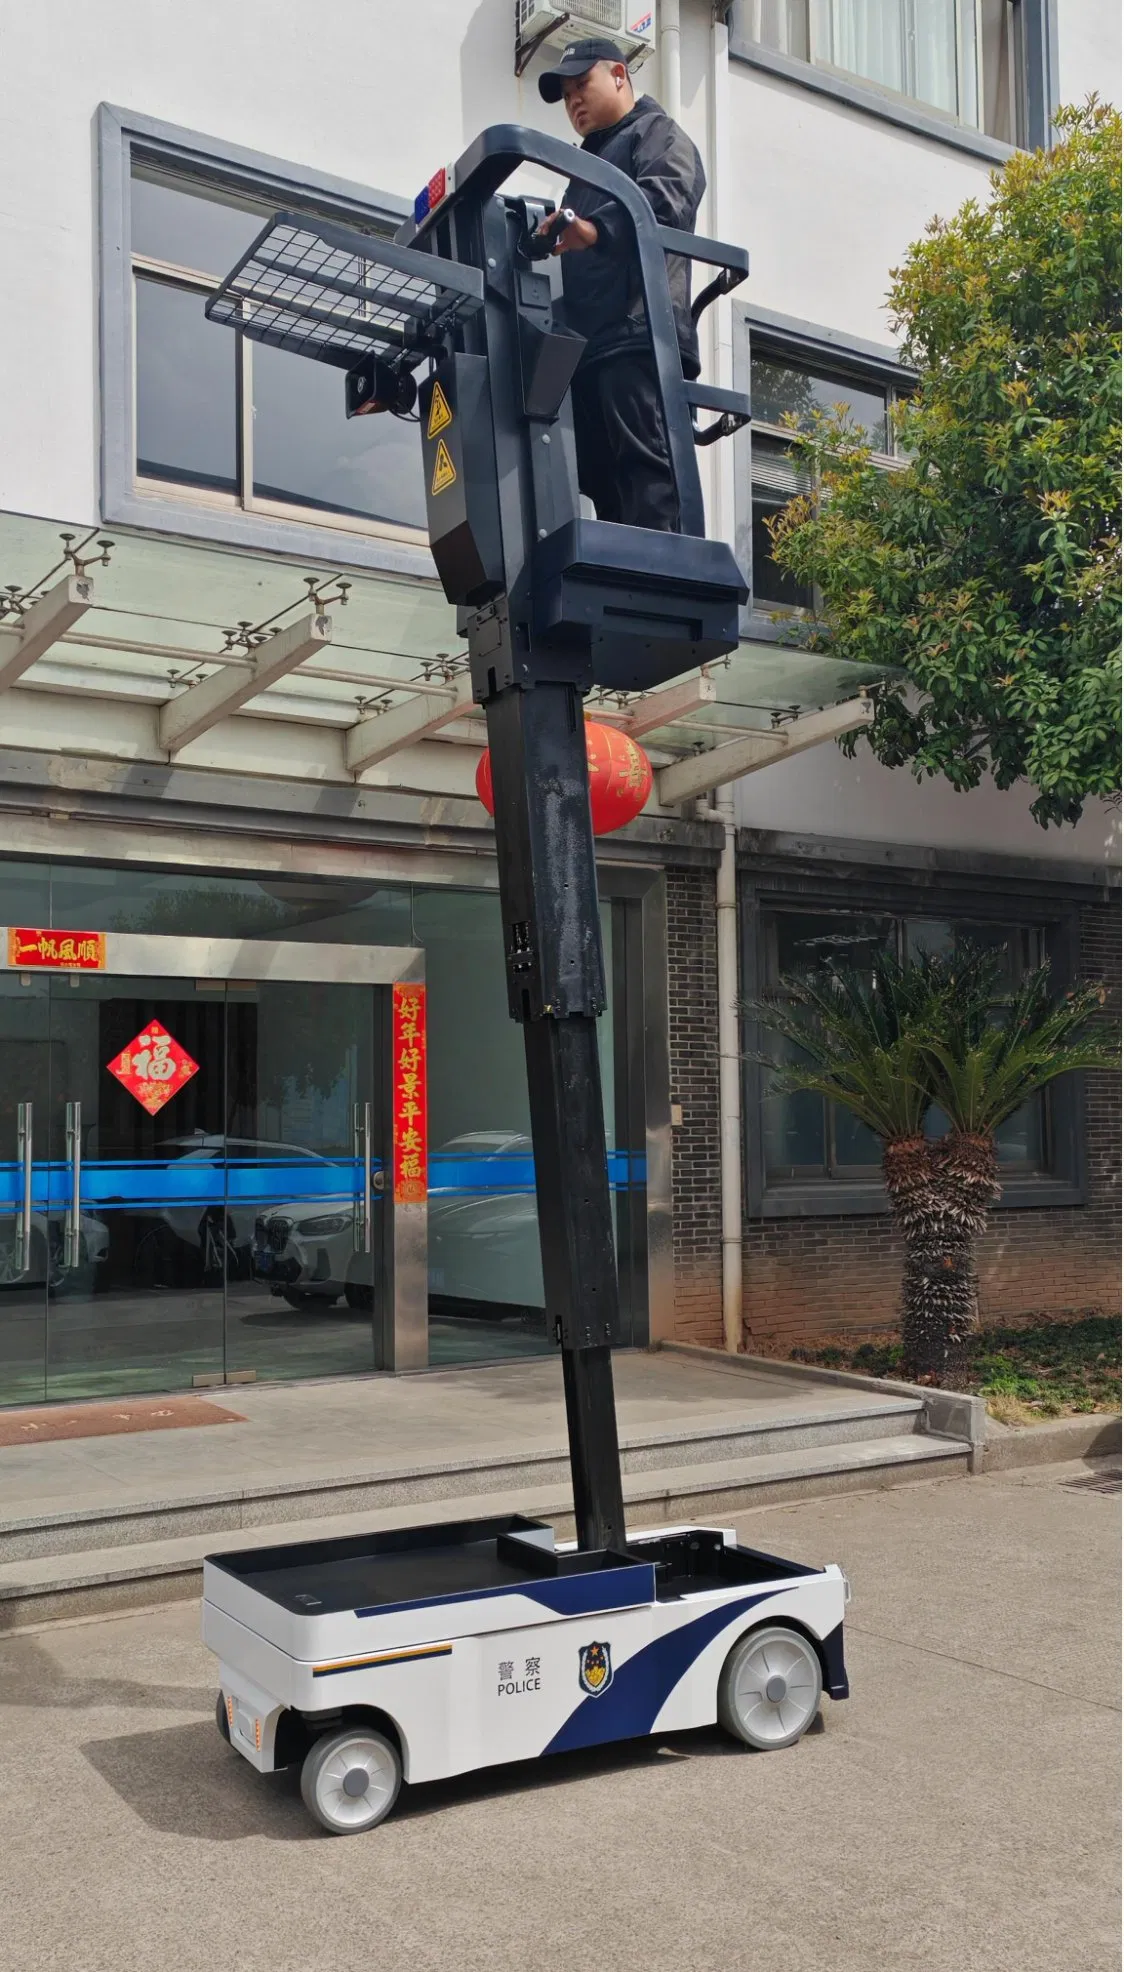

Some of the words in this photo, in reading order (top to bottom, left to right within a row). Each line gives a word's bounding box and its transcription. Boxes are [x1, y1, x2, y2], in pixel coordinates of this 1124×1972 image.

[132, 1035, 176, 1080] 福
[498, 1657, 541, 1680] 警察
[497, 1678, 541, 1696] POLICE
